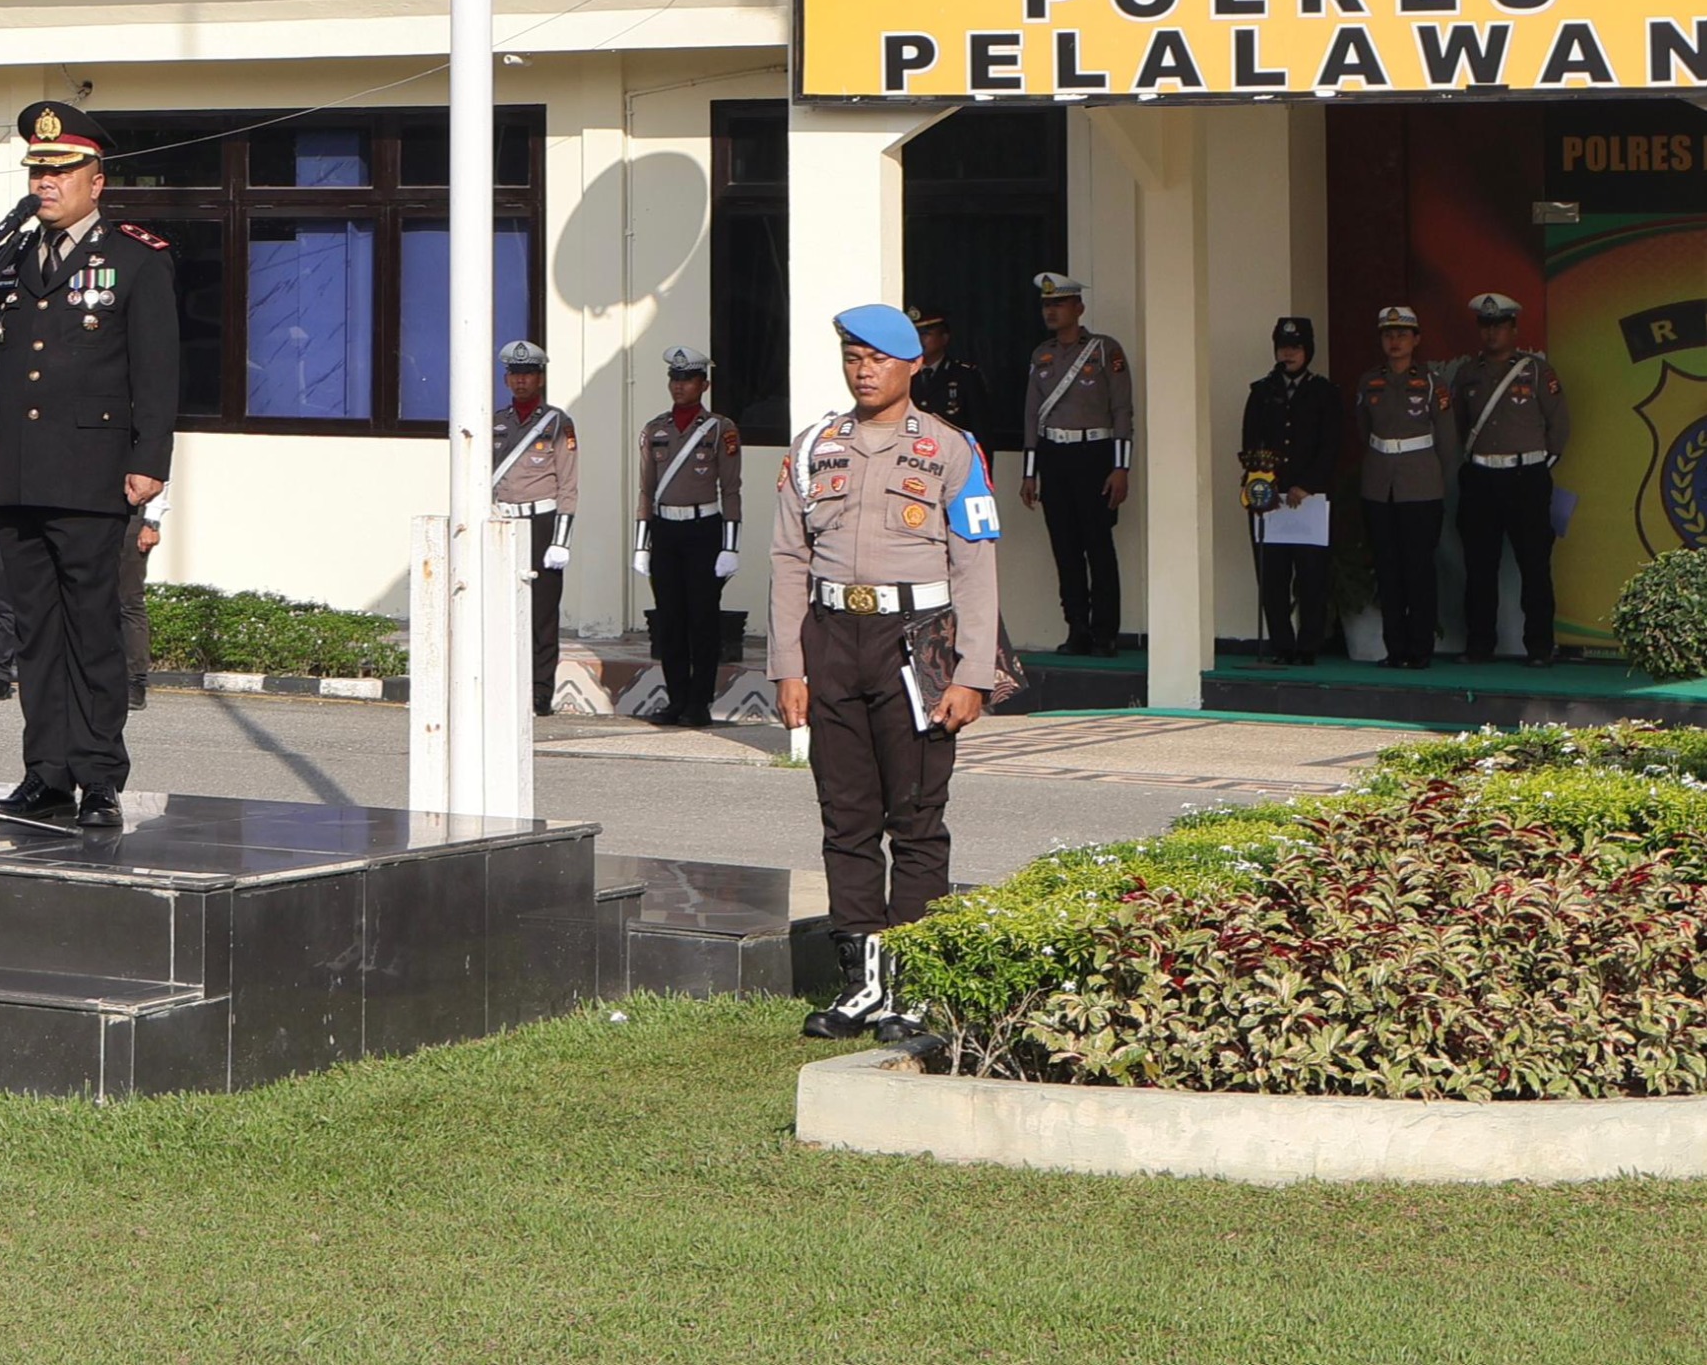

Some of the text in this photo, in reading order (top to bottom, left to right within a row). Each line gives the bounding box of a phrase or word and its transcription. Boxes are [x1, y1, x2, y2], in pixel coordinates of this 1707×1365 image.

[882, 17, 1707, 92] PELALAWAN
[1562, 134, 1693, 172] POLRES
[896, 455, 944, 476] POLRI
